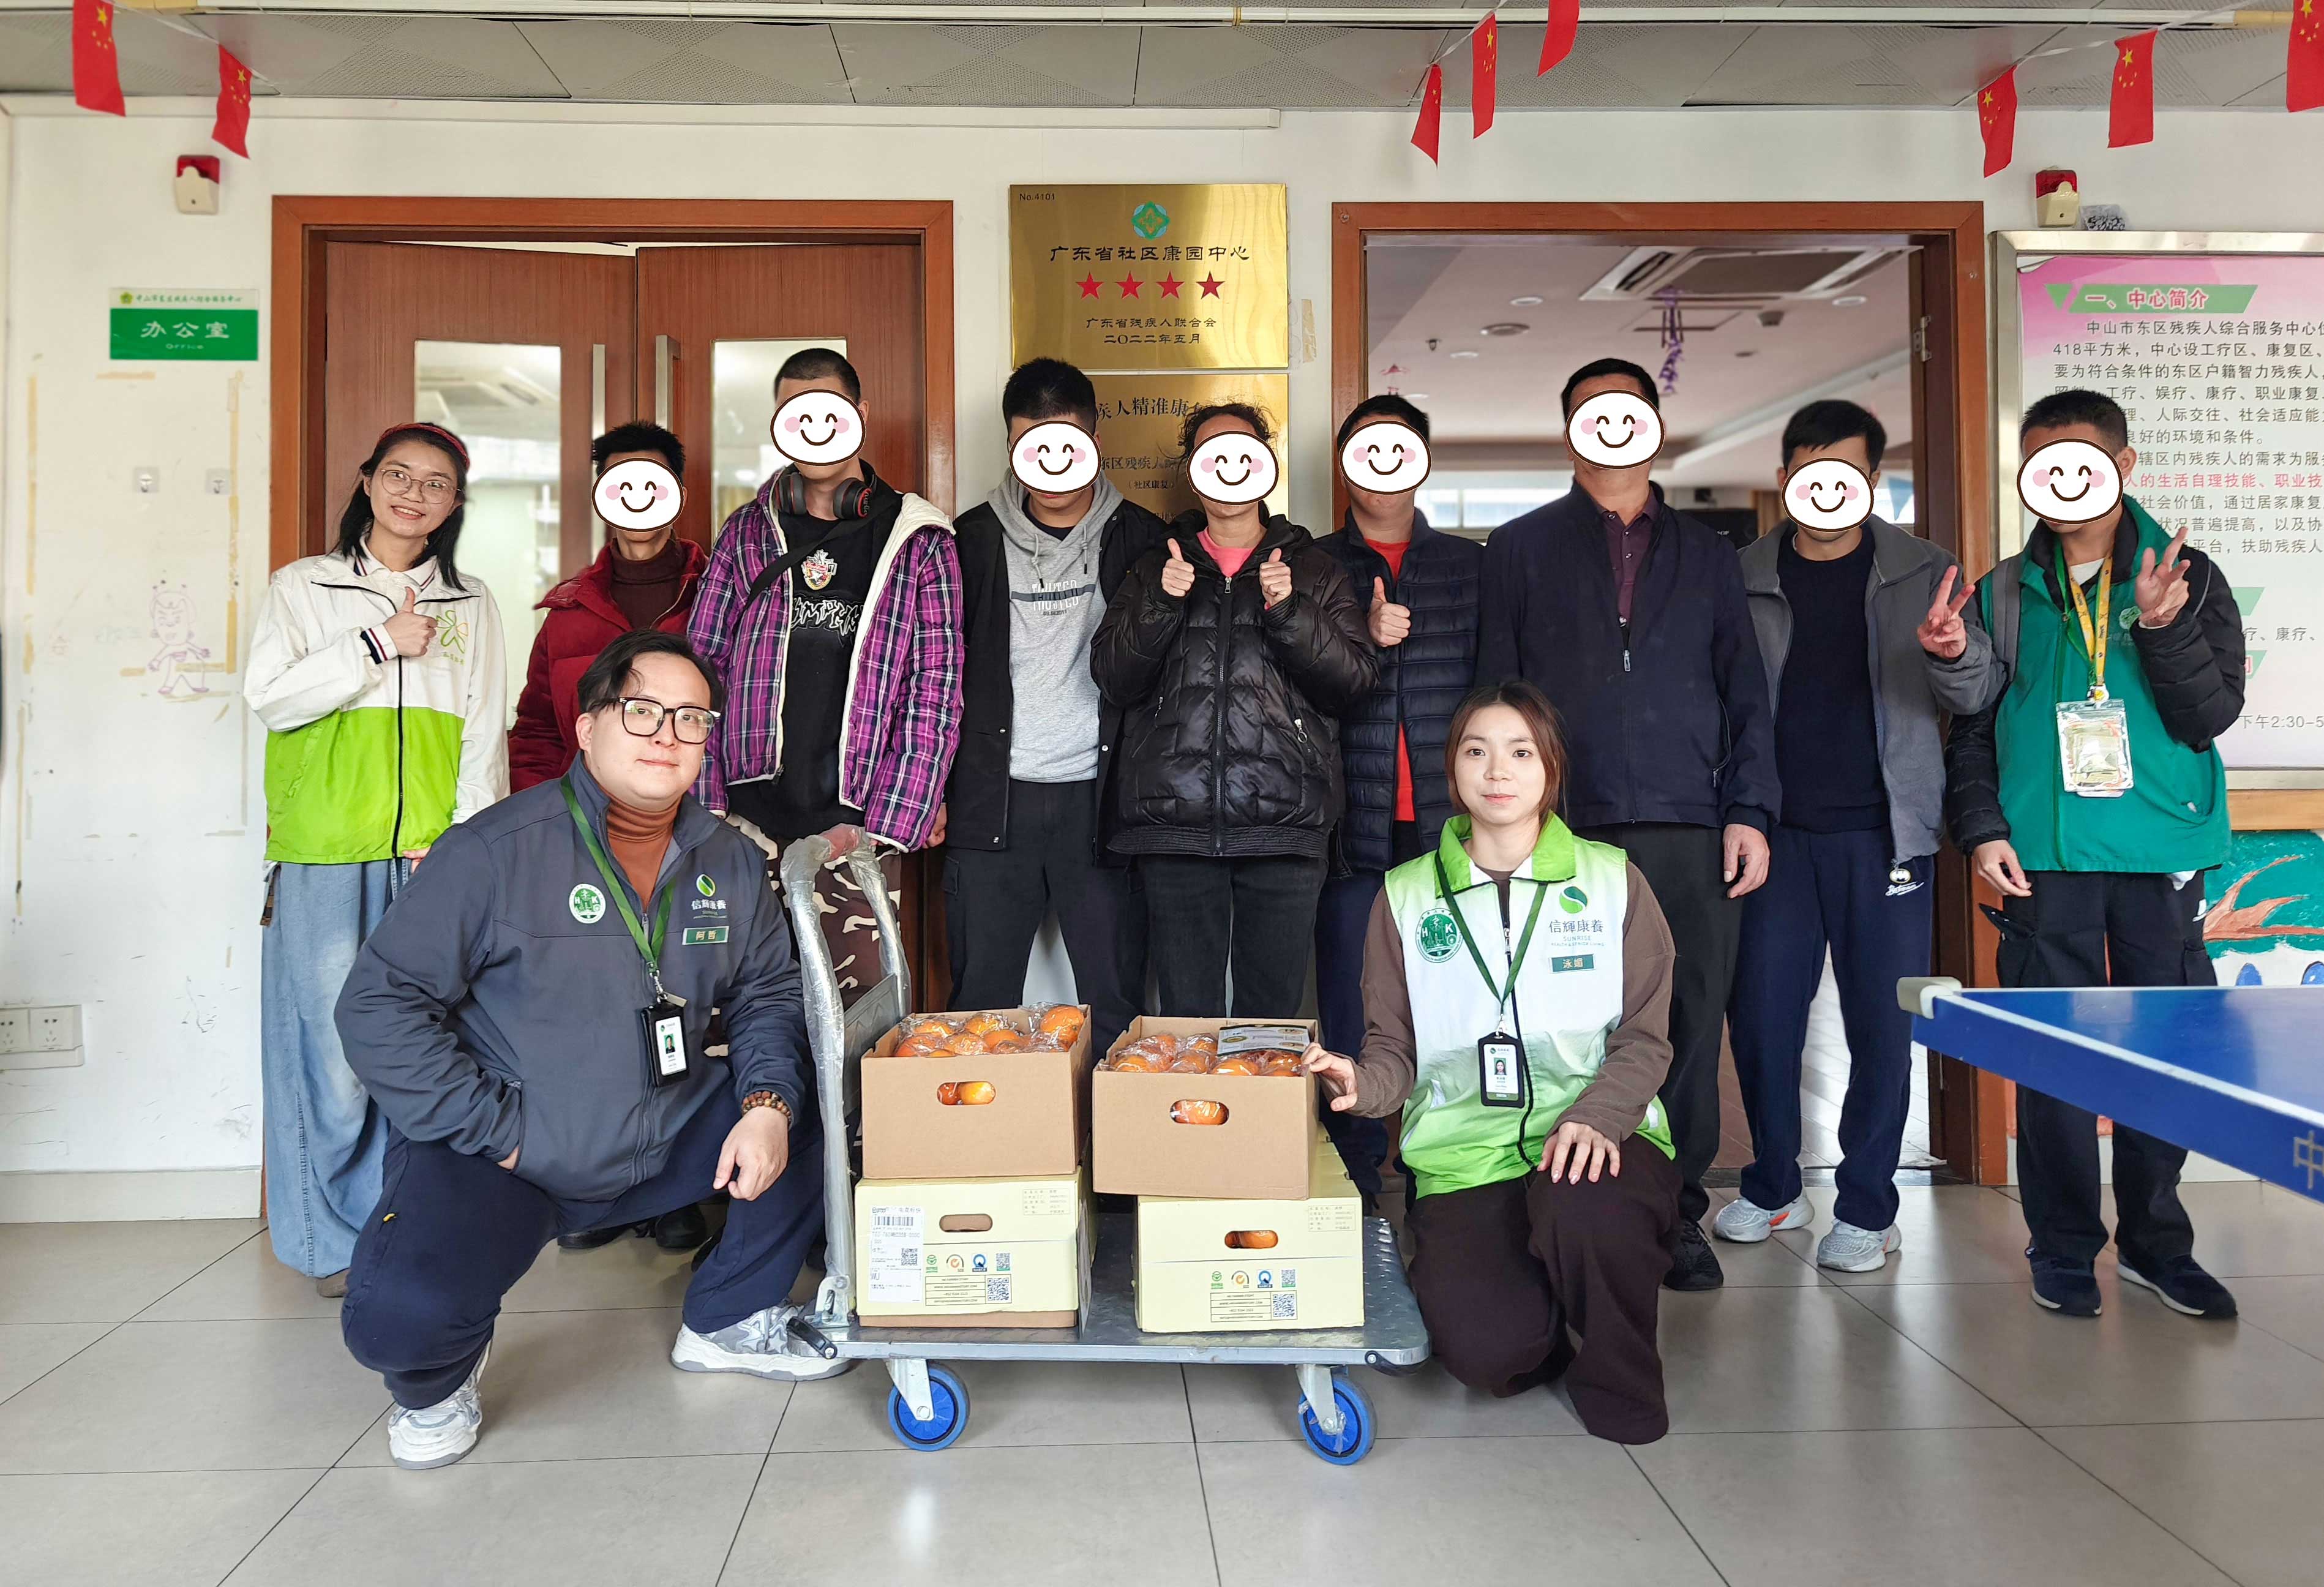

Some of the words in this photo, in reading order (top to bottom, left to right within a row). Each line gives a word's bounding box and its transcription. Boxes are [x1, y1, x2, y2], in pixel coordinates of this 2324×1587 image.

[1019, 192, 1055, 201] No.4101
[1050, 245, 1250, 262] 广东省社区康园中心
[2085, 289, 2209, 309] 一、中心简介
[140, 320, 230, 339] 办公室
[1085, 317, 1217, 329] 广东省残疾人联合会
[2123, 407, 2324, 423] 理、人际交往、社会适应能
[2138, 451, 2324, 467] 辖区内残疾人的需求为服
[2124, 473, 2323, 489] 人的生活自理技能、职业技
[2131, 494, 2324, 511] 社会价值，通过居家康复、
[2184, 539, 2323, 554] 平台，扶助残疾人
[1422, 926, 1428, 938] H
[1445, 923, 1454, 934] K
[1548, 919, 1604, 933] 信輝康養
